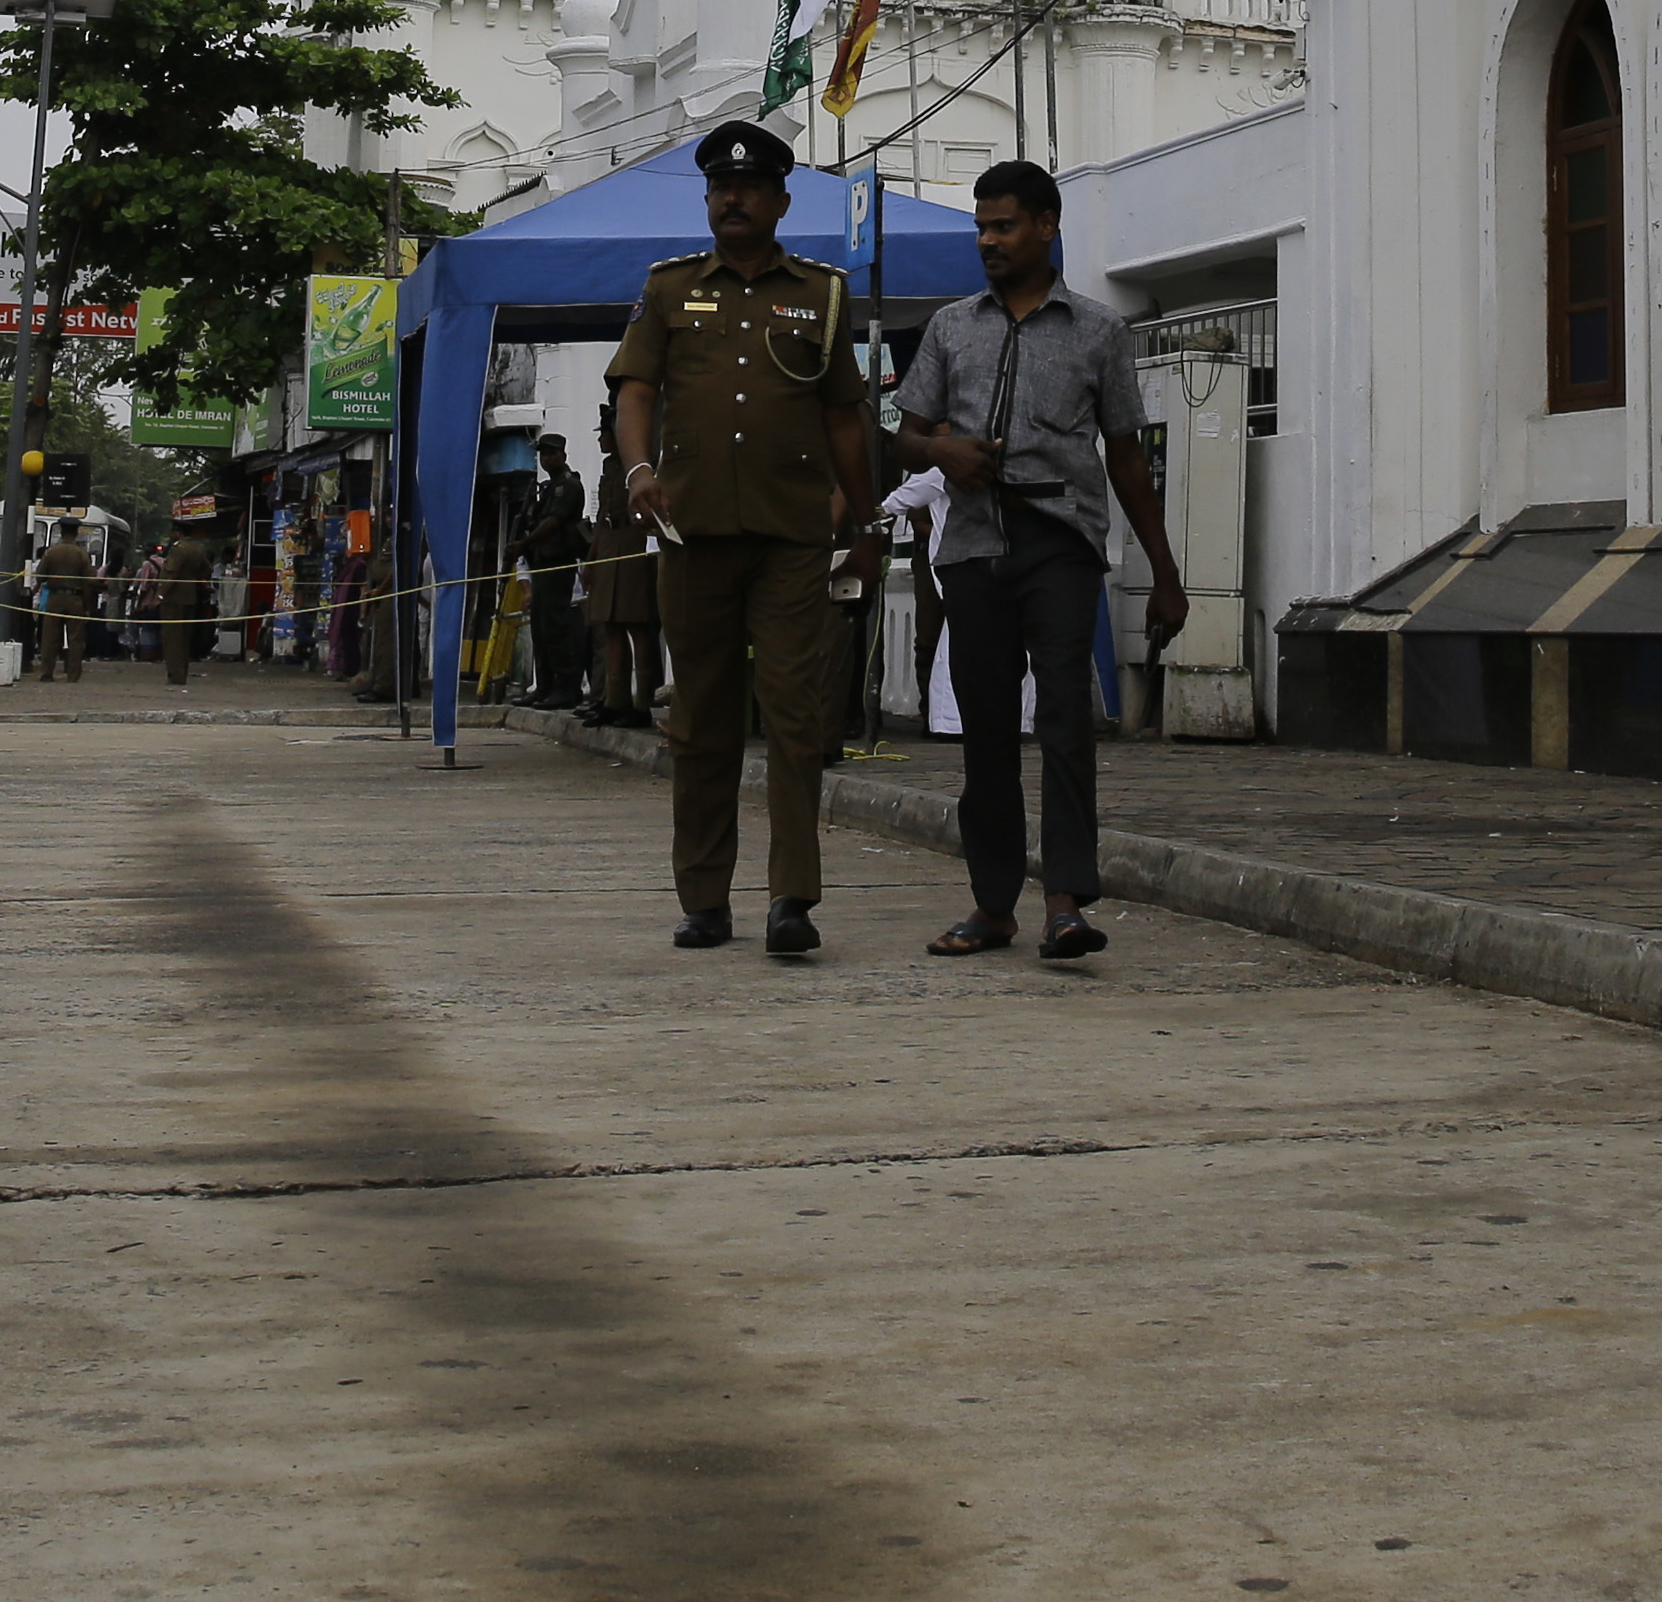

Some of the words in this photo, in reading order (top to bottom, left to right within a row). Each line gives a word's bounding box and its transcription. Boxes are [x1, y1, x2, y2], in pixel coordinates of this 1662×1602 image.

[851, 180, 868, 252] P
[10, 268, 24, 280] to
[12, 308, 85, 328] Fsst
[91, 311, 137, 329] Netw
[323, 349, 382, 383] Lemonade
[332, 390, 391, 402] BISMILLAH
[343, 403, 379, 414] HOTEL
[177, 409, 193, 420] DE
[195, 410, 231, 422] IMRAN
